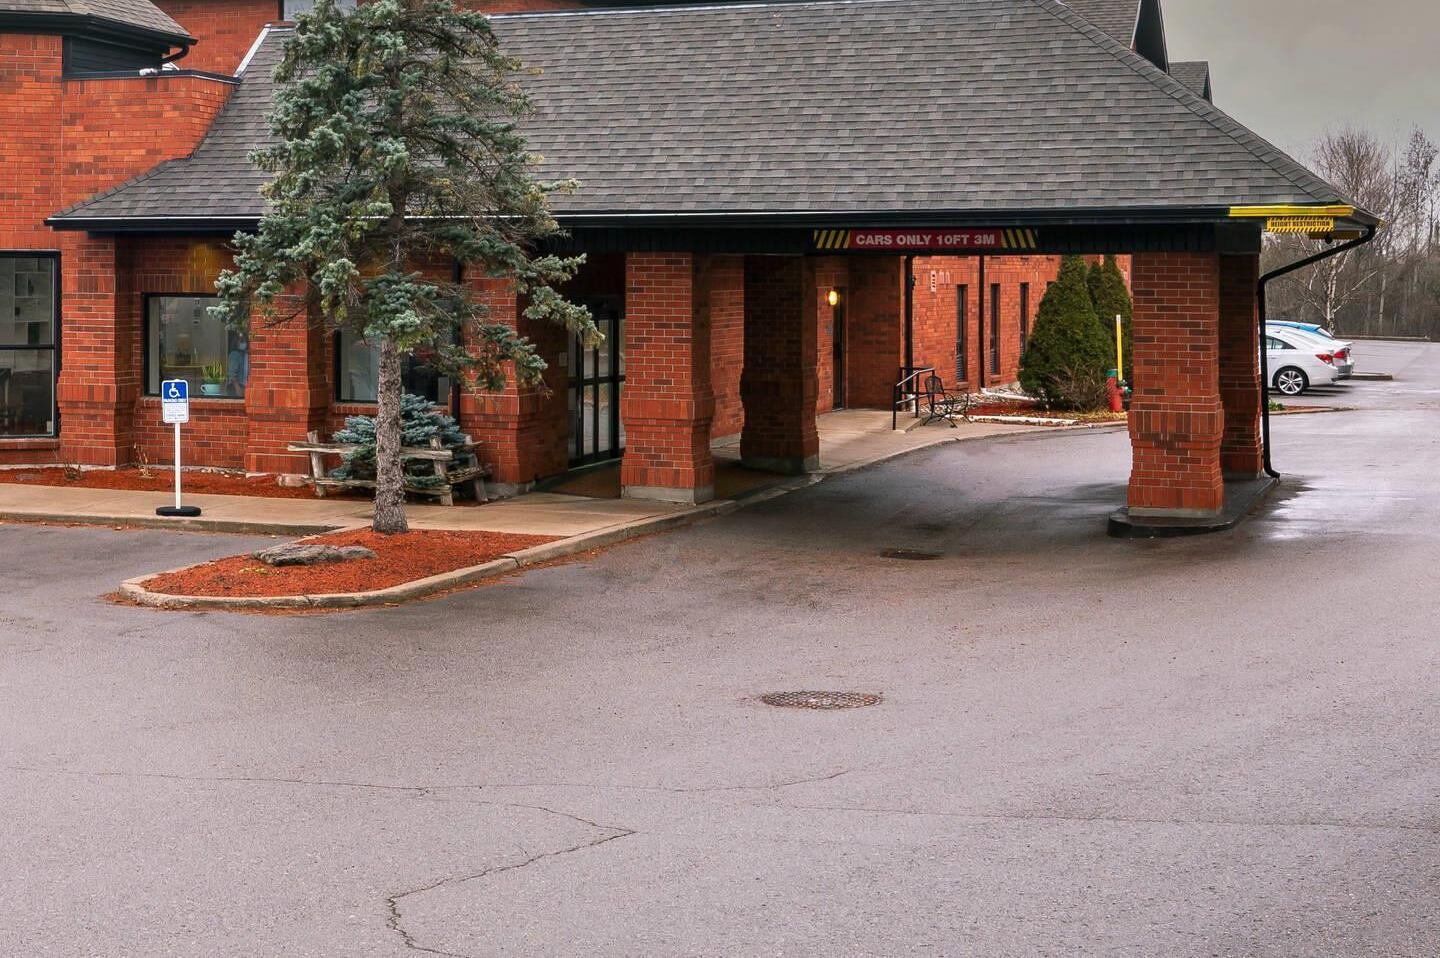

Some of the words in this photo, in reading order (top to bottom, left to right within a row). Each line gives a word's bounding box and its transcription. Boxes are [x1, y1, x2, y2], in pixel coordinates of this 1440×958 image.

[855, 234, 893, 245] CARS
[896, 234, 932, 245] ONLY
[936, 234, 970, 245] 10FT
[973, 234, 995, 245] 3M
